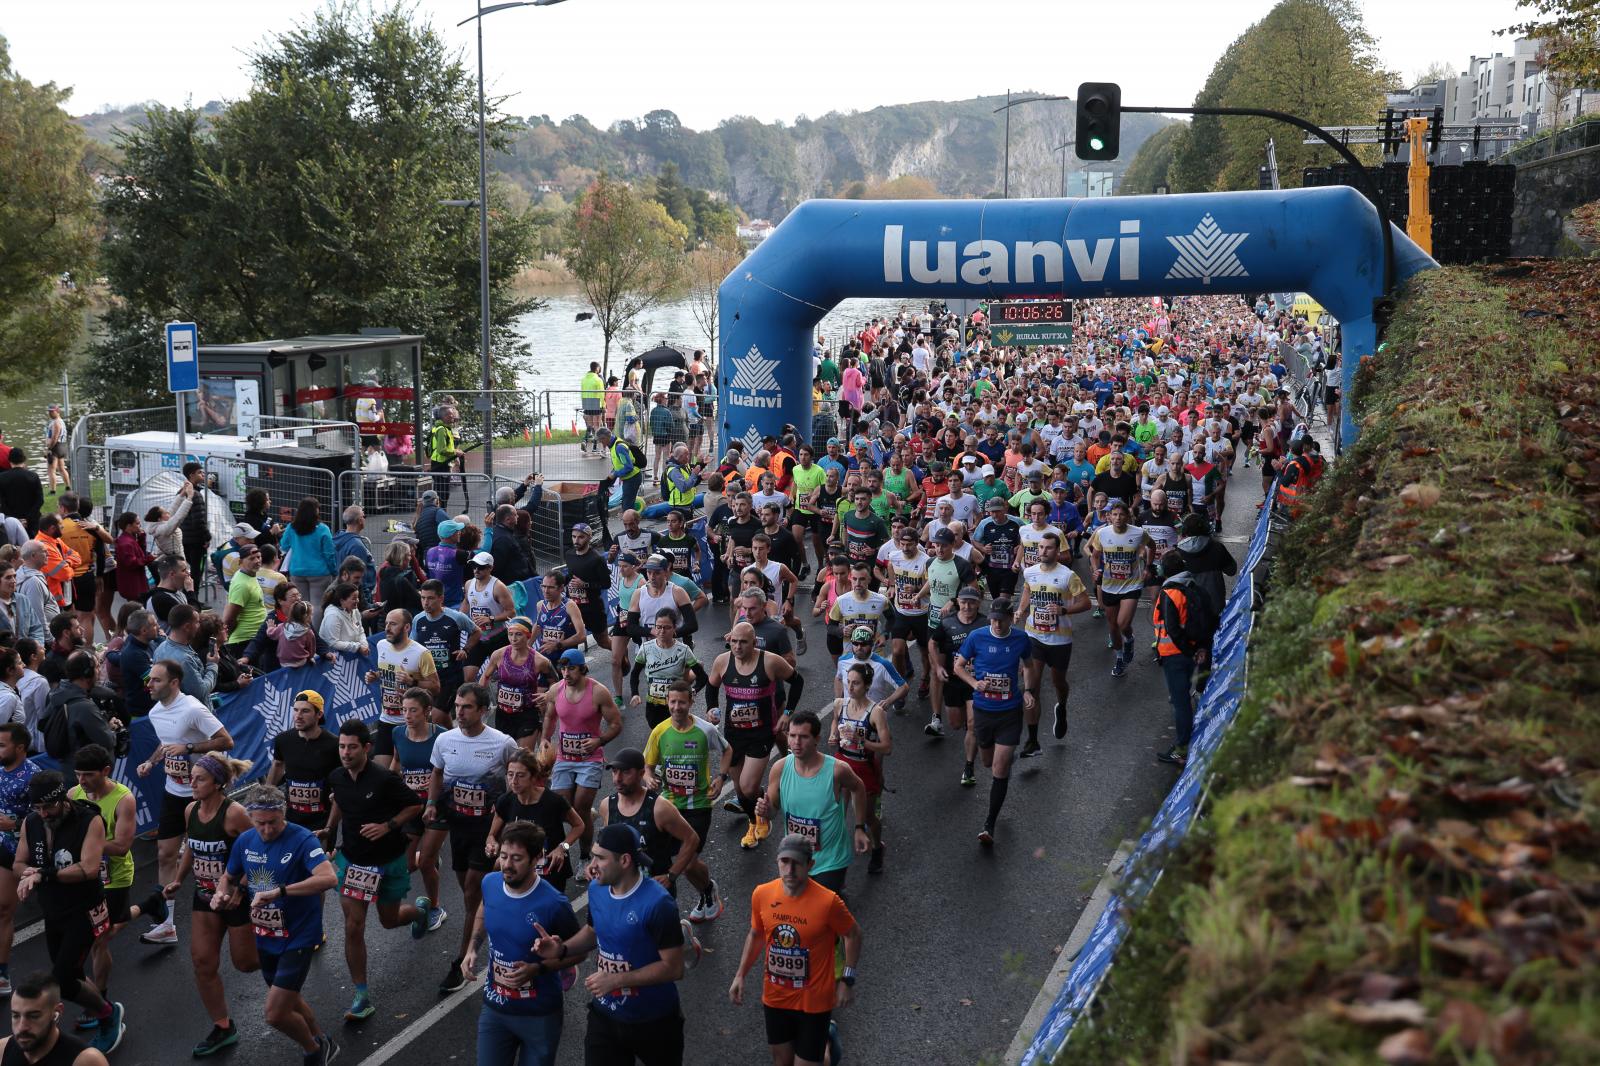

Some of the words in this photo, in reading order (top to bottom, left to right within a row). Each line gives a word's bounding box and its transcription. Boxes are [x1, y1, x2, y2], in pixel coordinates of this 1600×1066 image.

[884, 219, 1140, 285] luanvi
[1004, 305, 1063, 320] 10:06:26
[1016, 333, 1040, 341] RURAL
[1041, 332, 1068, 340] KUTXA
[729, 390, 782, 409] luanvi
[1035, 613, 1055, 621] 3681
[544, 631, 564, 640] 3447
[499, 690, 521, 702] 3079
[335, 697, 378, 728] luanvi
[732, 708, 757, 718] 3647
[563, 740, 582, 749] 312
[165, 760, 187, 771] 4162
[667, 770, 695, 781] 3829
[290, 788, 319, 799] 4330
[455, 788, 483, 801] 3711
[788, 821, 816, 837] 3204
[194, 859, 220, 873] 3111
[348, 868, 378, 885] 3271
[772, 912, 808, 925] PAMPLONA
[769, 955, 804, 970] 3989
